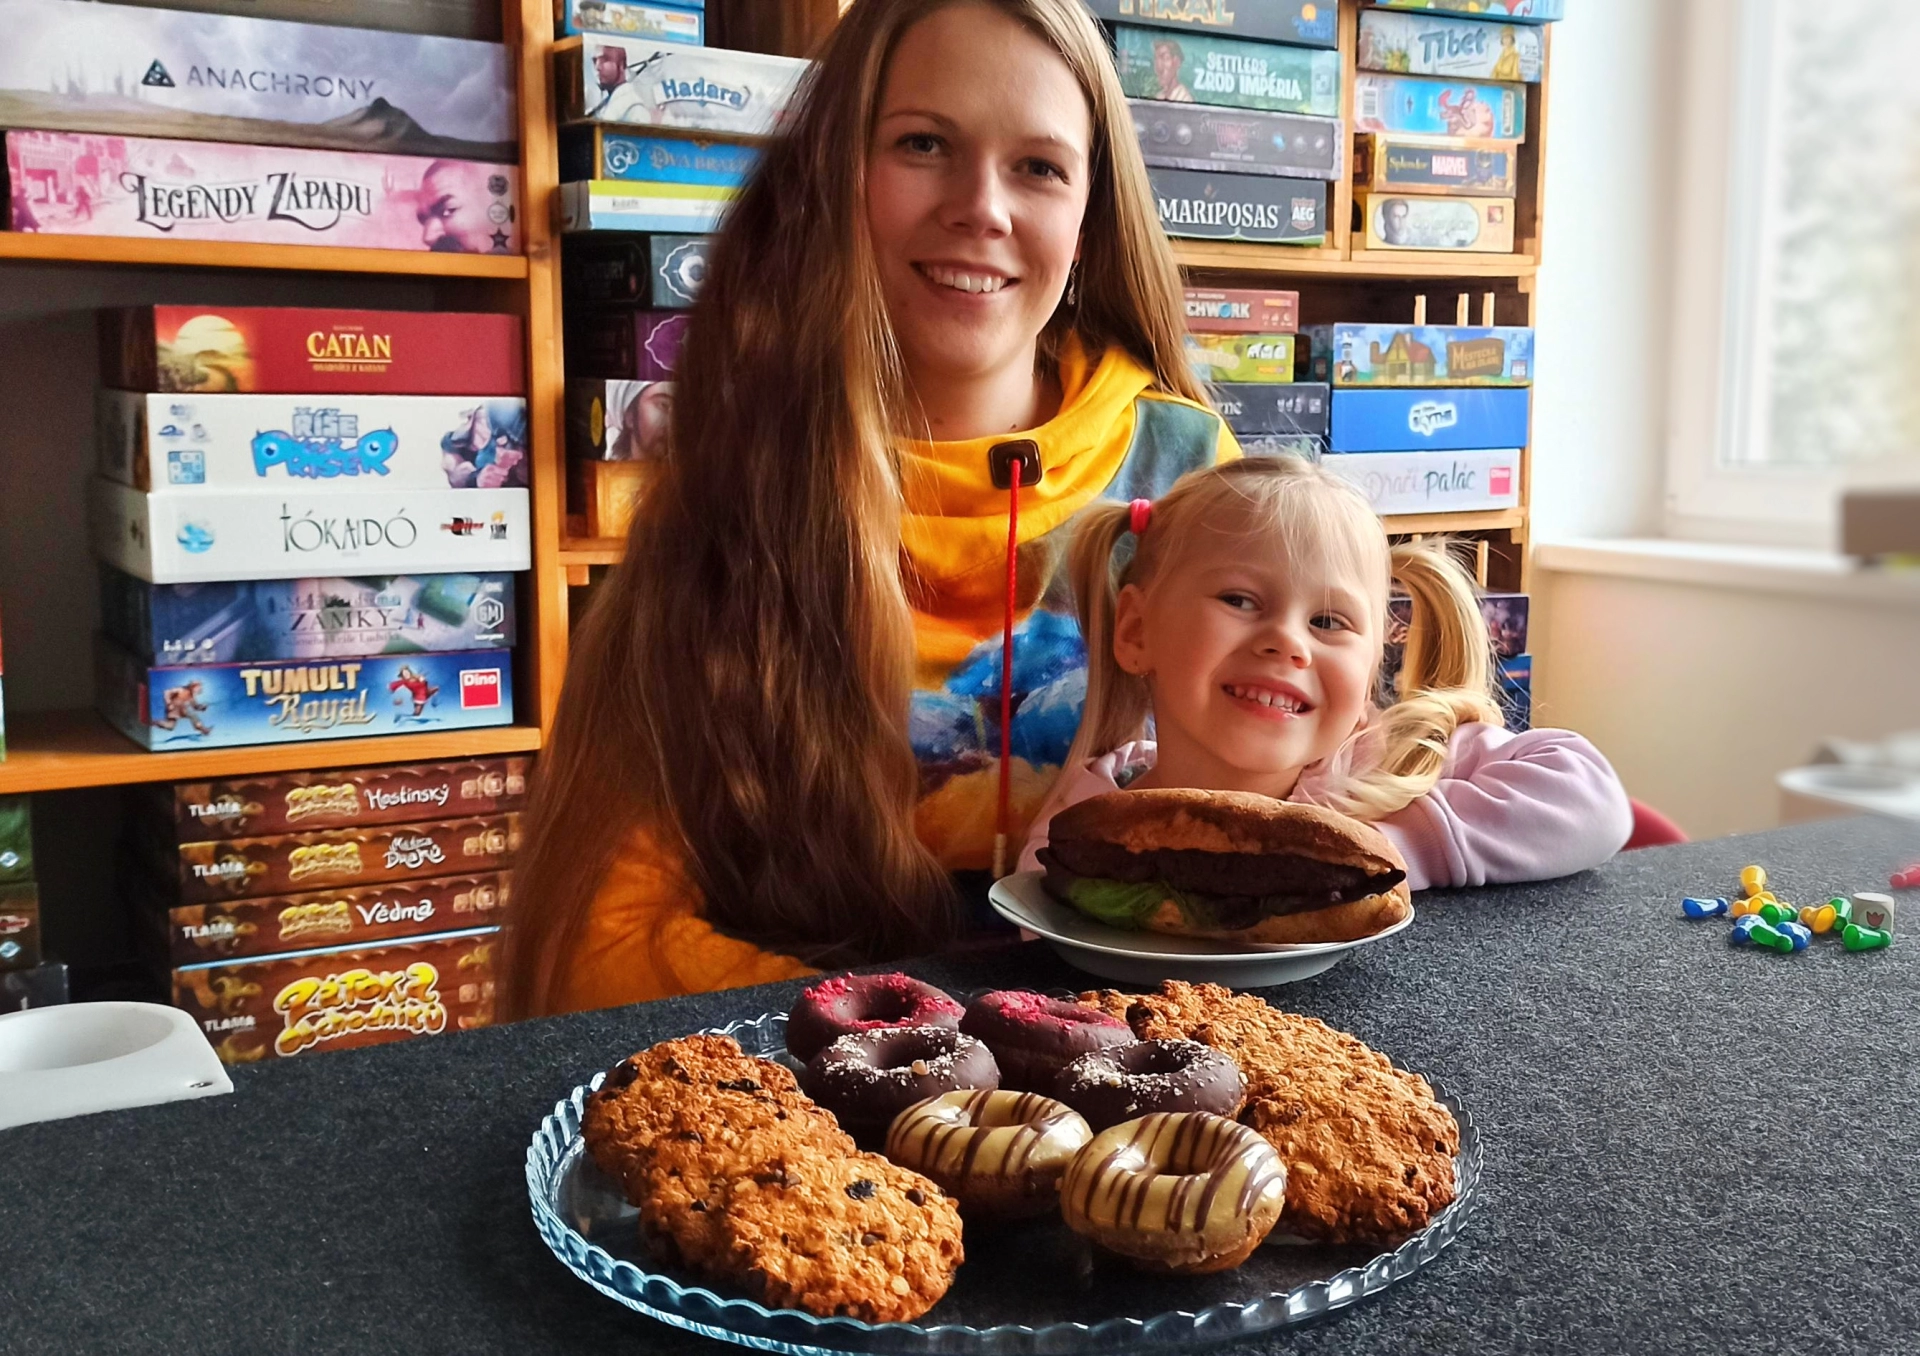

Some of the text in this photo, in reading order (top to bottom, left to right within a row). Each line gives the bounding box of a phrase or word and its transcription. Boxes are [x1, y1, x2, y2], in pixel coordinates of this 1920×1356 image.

[1206, 51, 1268, 77] SETTLERS
[186, 65, 376, 100] ANACHRONY
[661, 77, 743, 106] Hadara
[1193, 67, 1303, 101] ZROD IMPÉRIA
[1432, 155, 1468, 176] MARVEL
[119, 172, 372, 232] LEGENDY ZÁPADU
[1158, 198, 1279, 229] MARIPOSAS
[1292, 205, 1315, 222] AEG
[1186, 301, 1251, 319] CHWORK
[306, 331, 392, 358] CATAN
[1424, 460, 1476, 500] palác
[240, 663, 362, 697] TUMULT
[463, 673, 498, 687] Dino
[264, 688, 377, 734] Royal
[363, 783, 450, 810] Hostinský
[356, 899, 436, 926] Vědma
[204, 1014, 256, 1032] TLAMA
